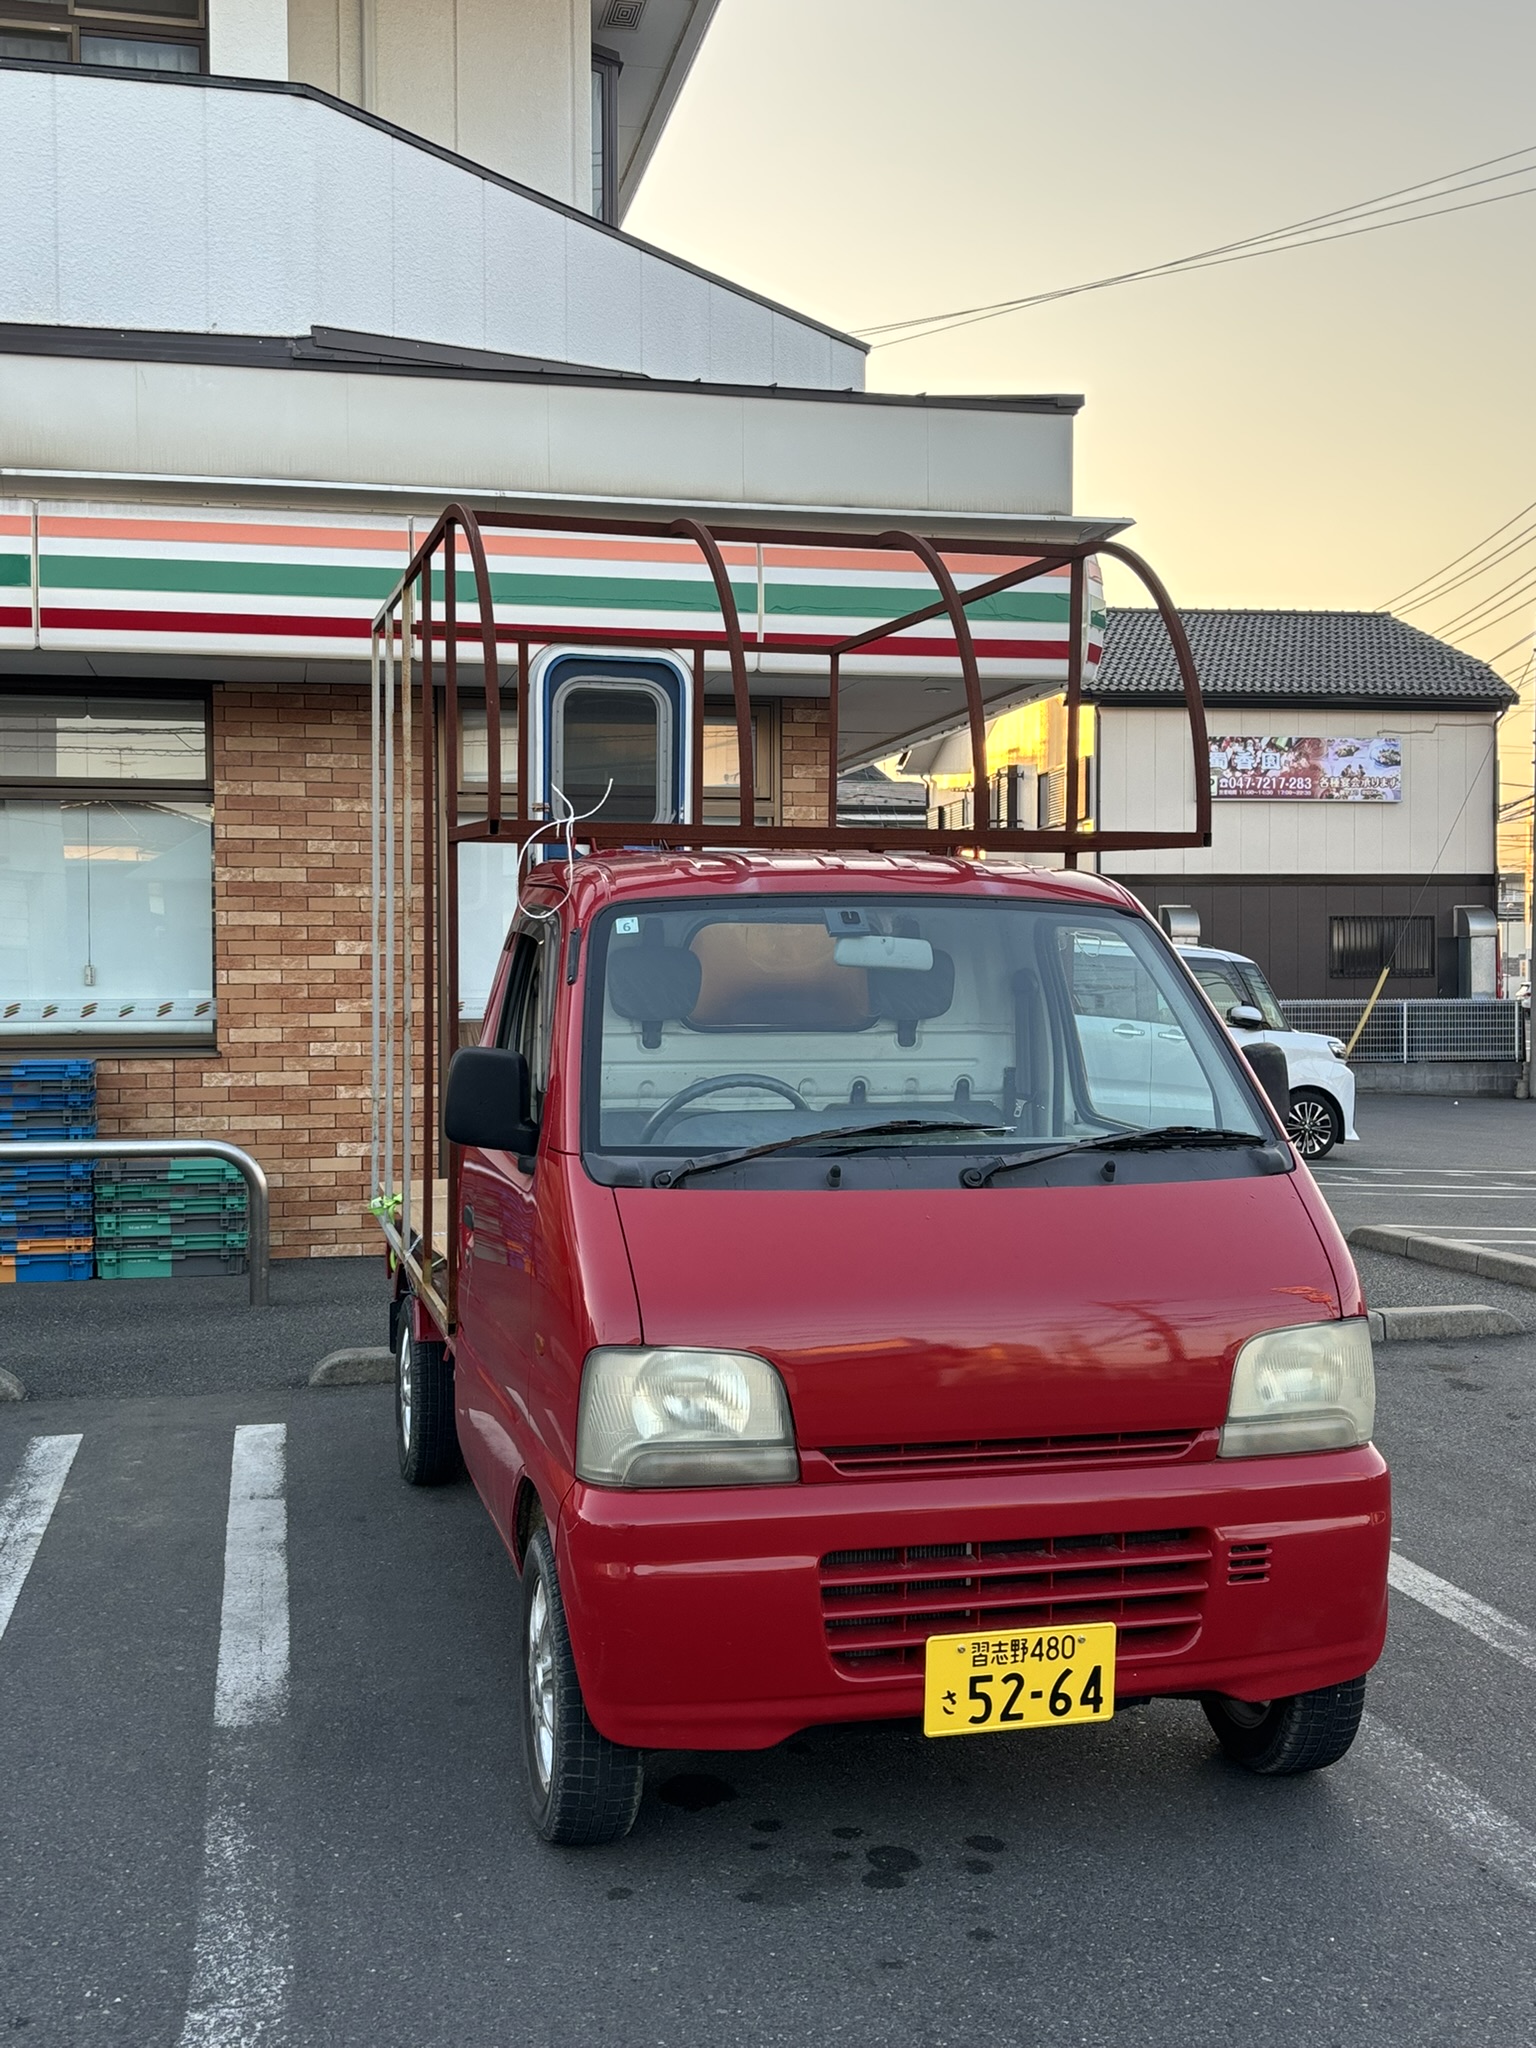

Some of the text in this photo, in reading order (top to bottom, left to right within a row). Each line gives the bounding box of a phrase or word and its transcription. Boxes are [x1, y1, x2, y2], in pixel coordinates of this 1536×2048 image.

[1319, 776, 1399, 789] 各種宴会承ります
[971, 1635, 1075, 1667] 習志野480
[941, 1665, 1103, 1724] さ 52-64
